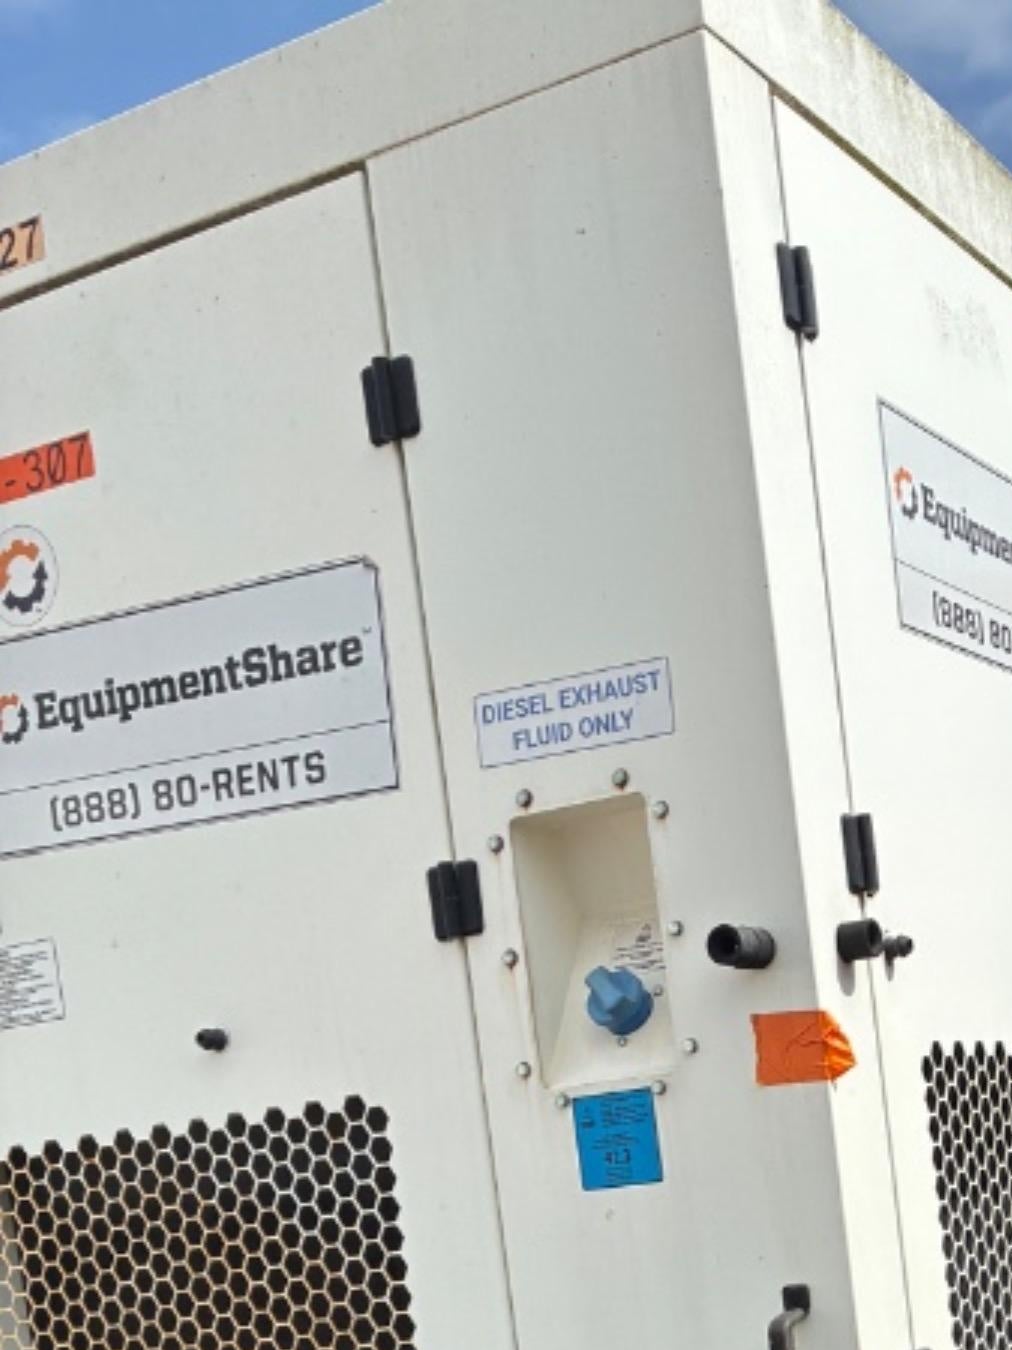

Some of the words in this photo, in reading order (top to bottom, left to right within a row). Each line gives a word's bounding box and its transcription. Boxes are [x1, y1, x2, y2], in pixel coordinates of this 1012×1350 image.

[931, 590, 985, 646] (888)
[33, 635, 364, 732] EquipmentShare
[481, 693, 554, 725] DIESEL
[559, 669, 661, 709] EXHAUST
[512, 722, 573, 750] FLUID
[578, 708, 634, 738] ONLY
[50, 782, 141, 831] (888)
[152, 751, 326, 811] 80-RENTS
